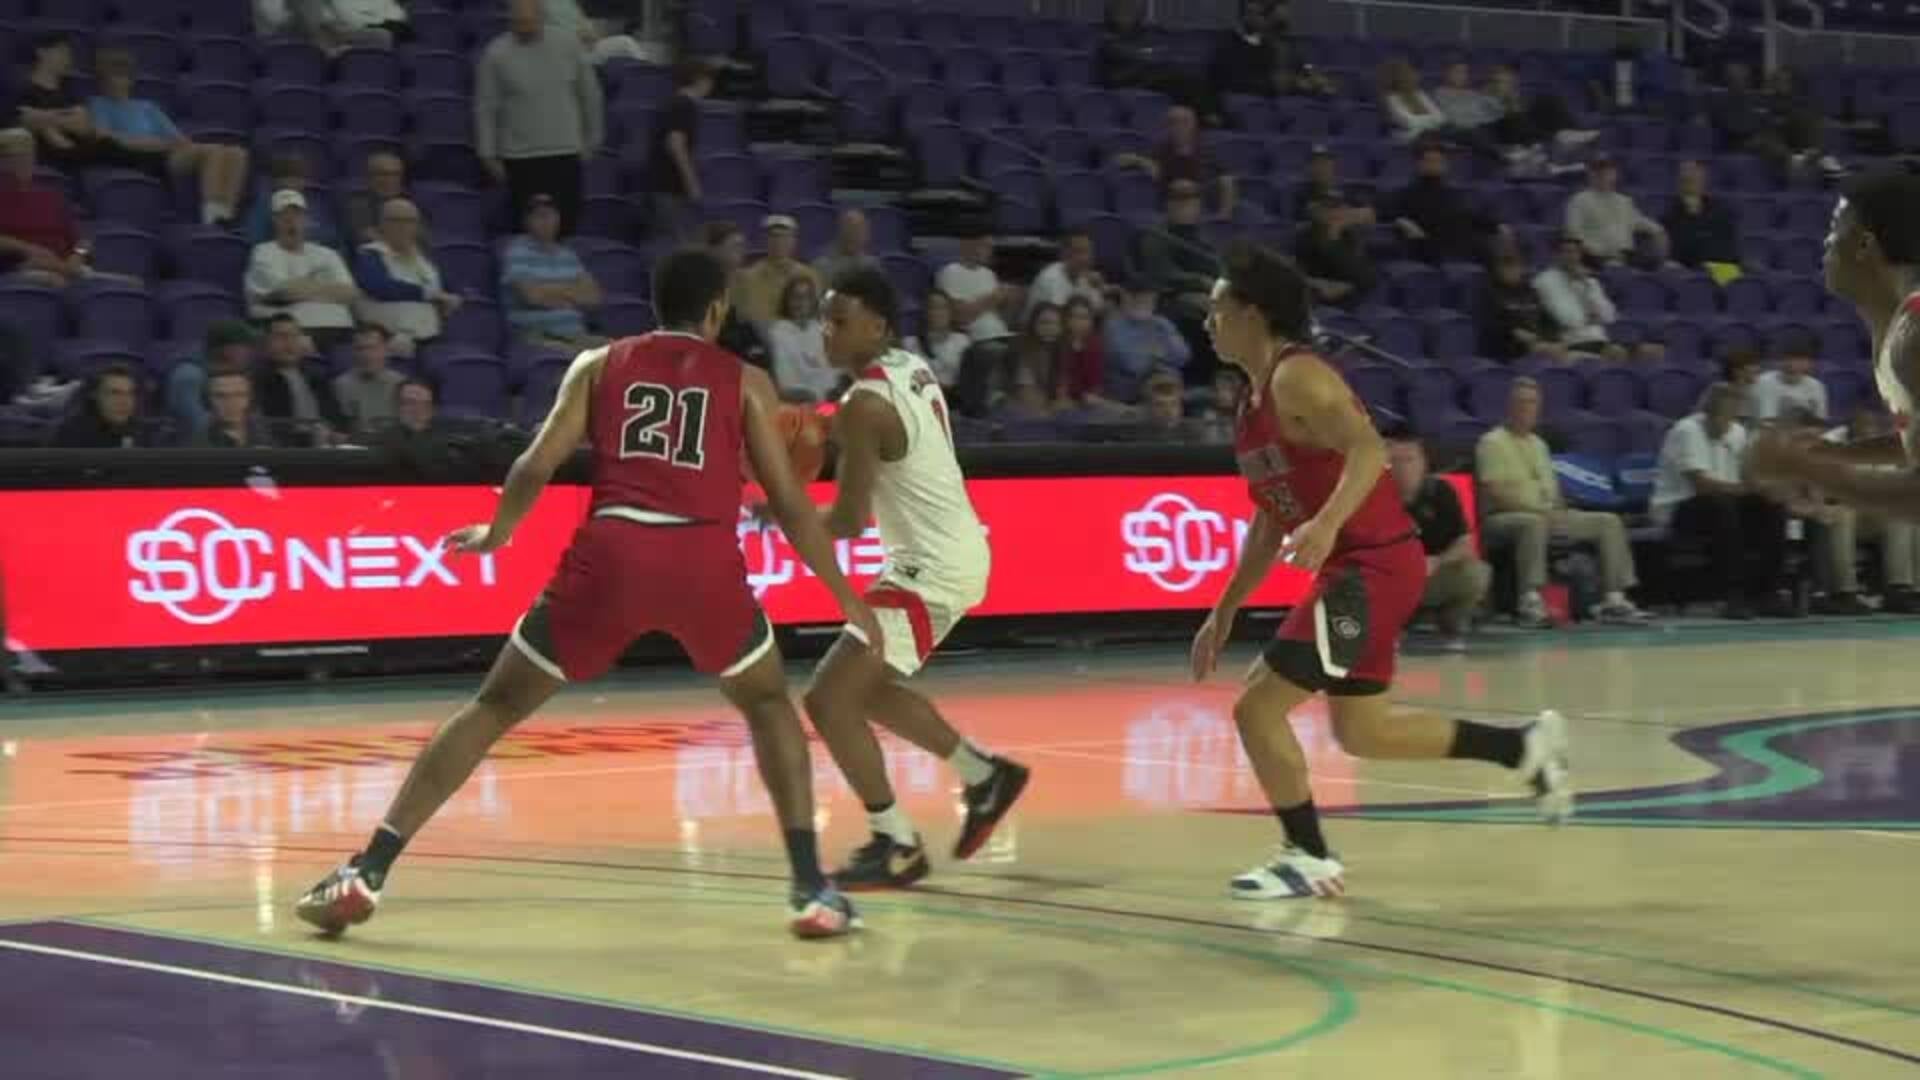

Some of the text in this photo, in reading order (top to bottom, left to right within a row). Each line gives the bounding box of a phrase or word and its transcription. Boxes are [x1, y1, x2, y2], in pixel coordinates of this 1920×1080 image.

[620, 382, 709, 470] 21
[127, 528, 276, 603] SC
[1121, 510, 1229, 574] SC
